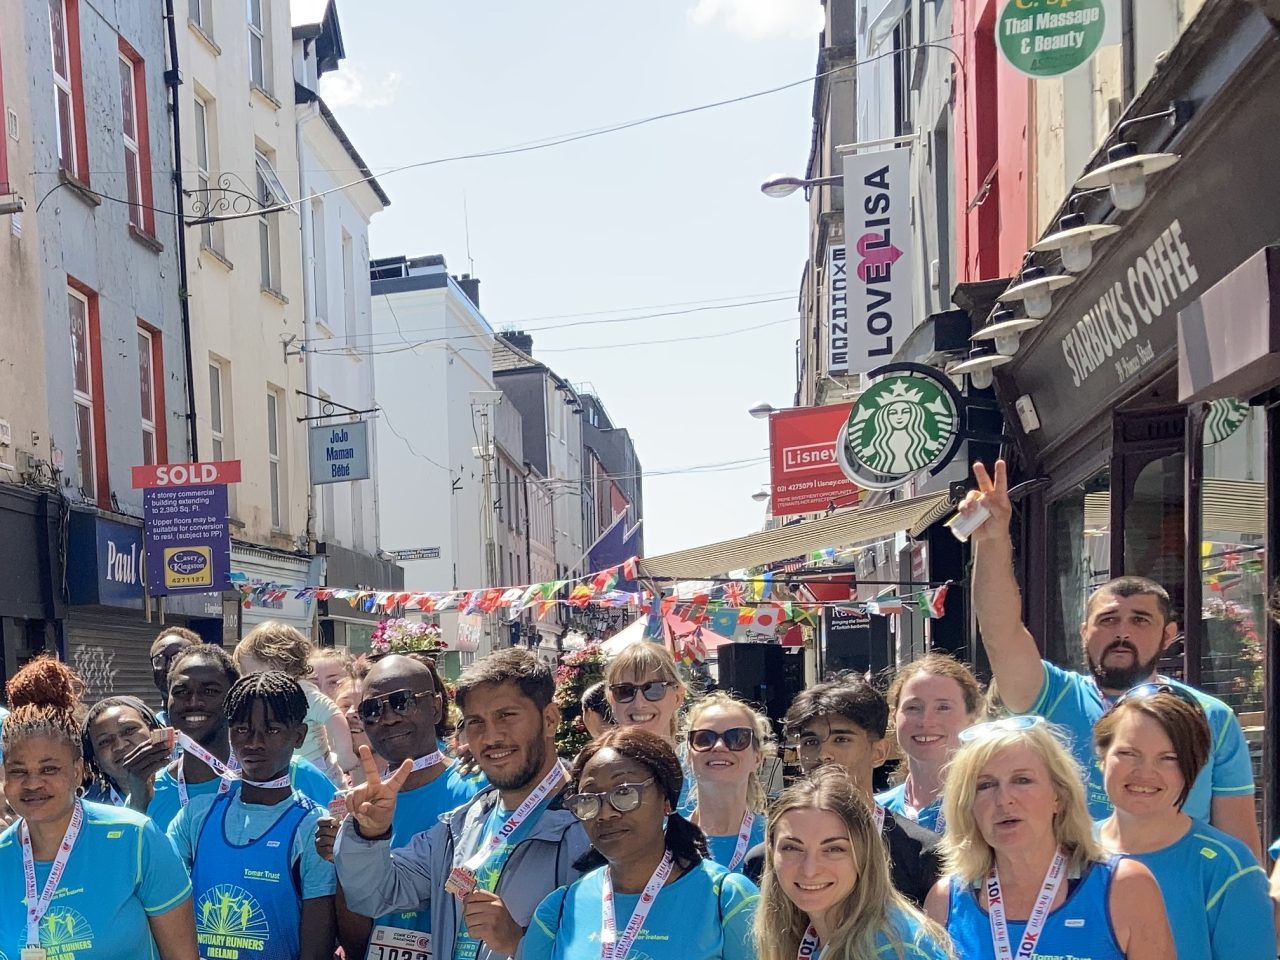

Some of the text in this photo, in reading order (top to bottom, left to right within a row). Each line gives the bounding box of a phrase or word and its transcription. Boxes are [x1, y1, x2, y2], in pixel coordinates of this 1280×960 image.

[1004, 7, 1100, 36] Thai Massage
[1021, 30, 1085, 54] & Beauty
[864, 164, 893, 357] LOVE LISA
[831, 248, 848, 366] EXCHANGE
[1062, 218, 1199, 388] STARBUCKS COFFEE
[330, 428, 349, 443] JoJo
[326, 446, 354, 461] Maman
[787, 448, 838, 465] Lisney
[156, 464, 218, 485] SOLD
[331, 463, 350, 478] Bébé
[157, 490, 177, 500] storey
[178, 489, 215, 498] commercial
[151, 498, 210, 508] building extending
[152, 519, 172, 527] Upper
[173, 517, 192, 525] floors
[193, 517, 207, 525] may
[153, 525, 178, 533] suitable
[189, 523, 224, 532] conversion
[106, 540, 137, 585] Paul
[499, 818, 520, 838] 10K
[244, 868, 281, 879] Tomar Trust
[987, 880, 1001, 907] 10K
[62, 940, 92, 952] RUNNERS
[225, 936, 264, 951] RUNNERS
[1018, 931, 1039, 960] 10K
[207, 947, 239, 960] IRELAND
